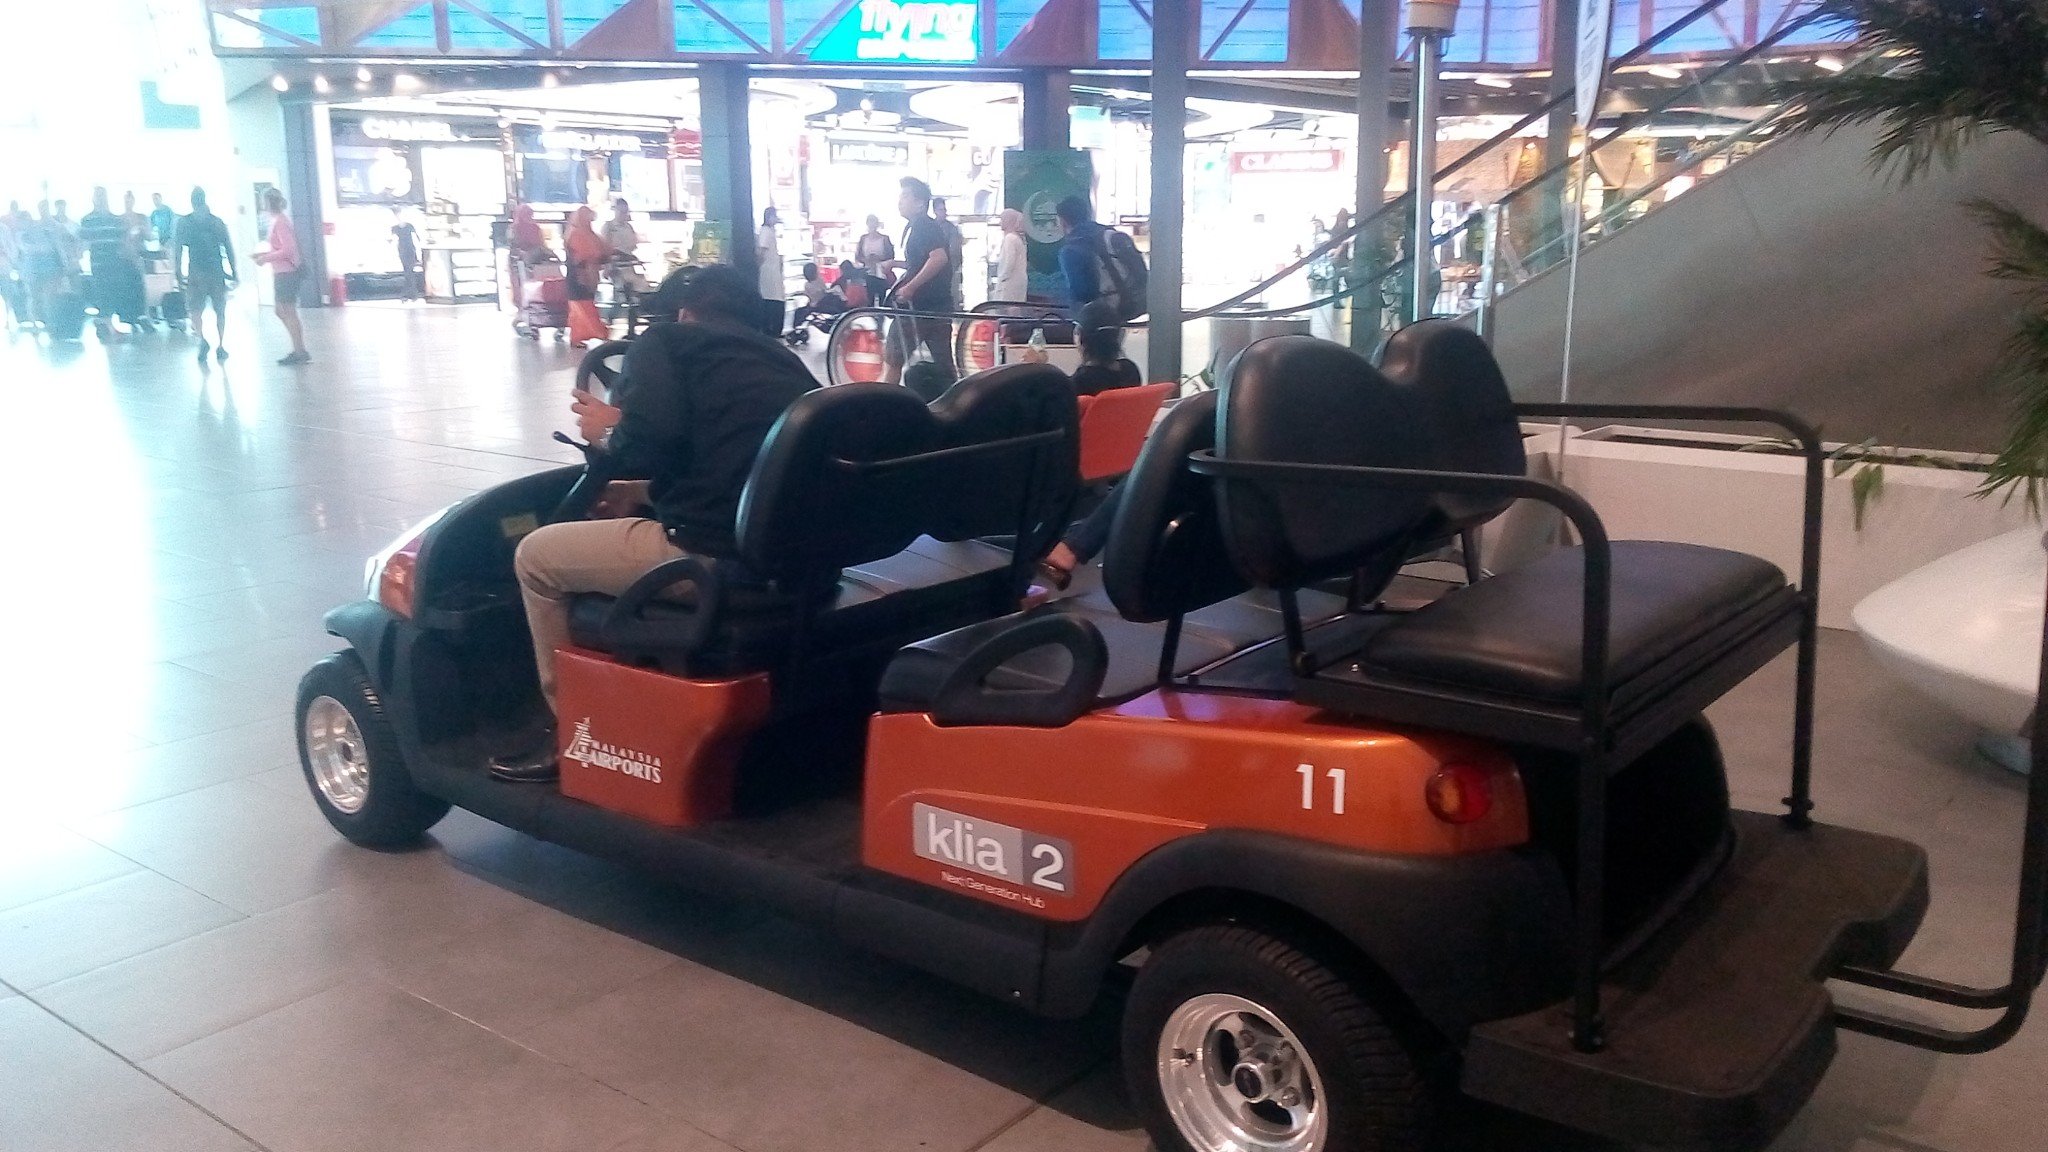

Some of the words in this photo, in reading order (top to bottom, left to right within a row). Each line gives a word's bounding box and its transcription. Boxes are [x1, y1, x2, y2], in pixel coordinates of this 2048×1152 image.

[590, 740, 662, 767] MALAYSIA
[590, 750, 662, 784] AIRPORTS
[1296, 763, 1346, 815] 11
[927, 812, 1008, 875] klia
[1031, 843, 1065, 892] 2
